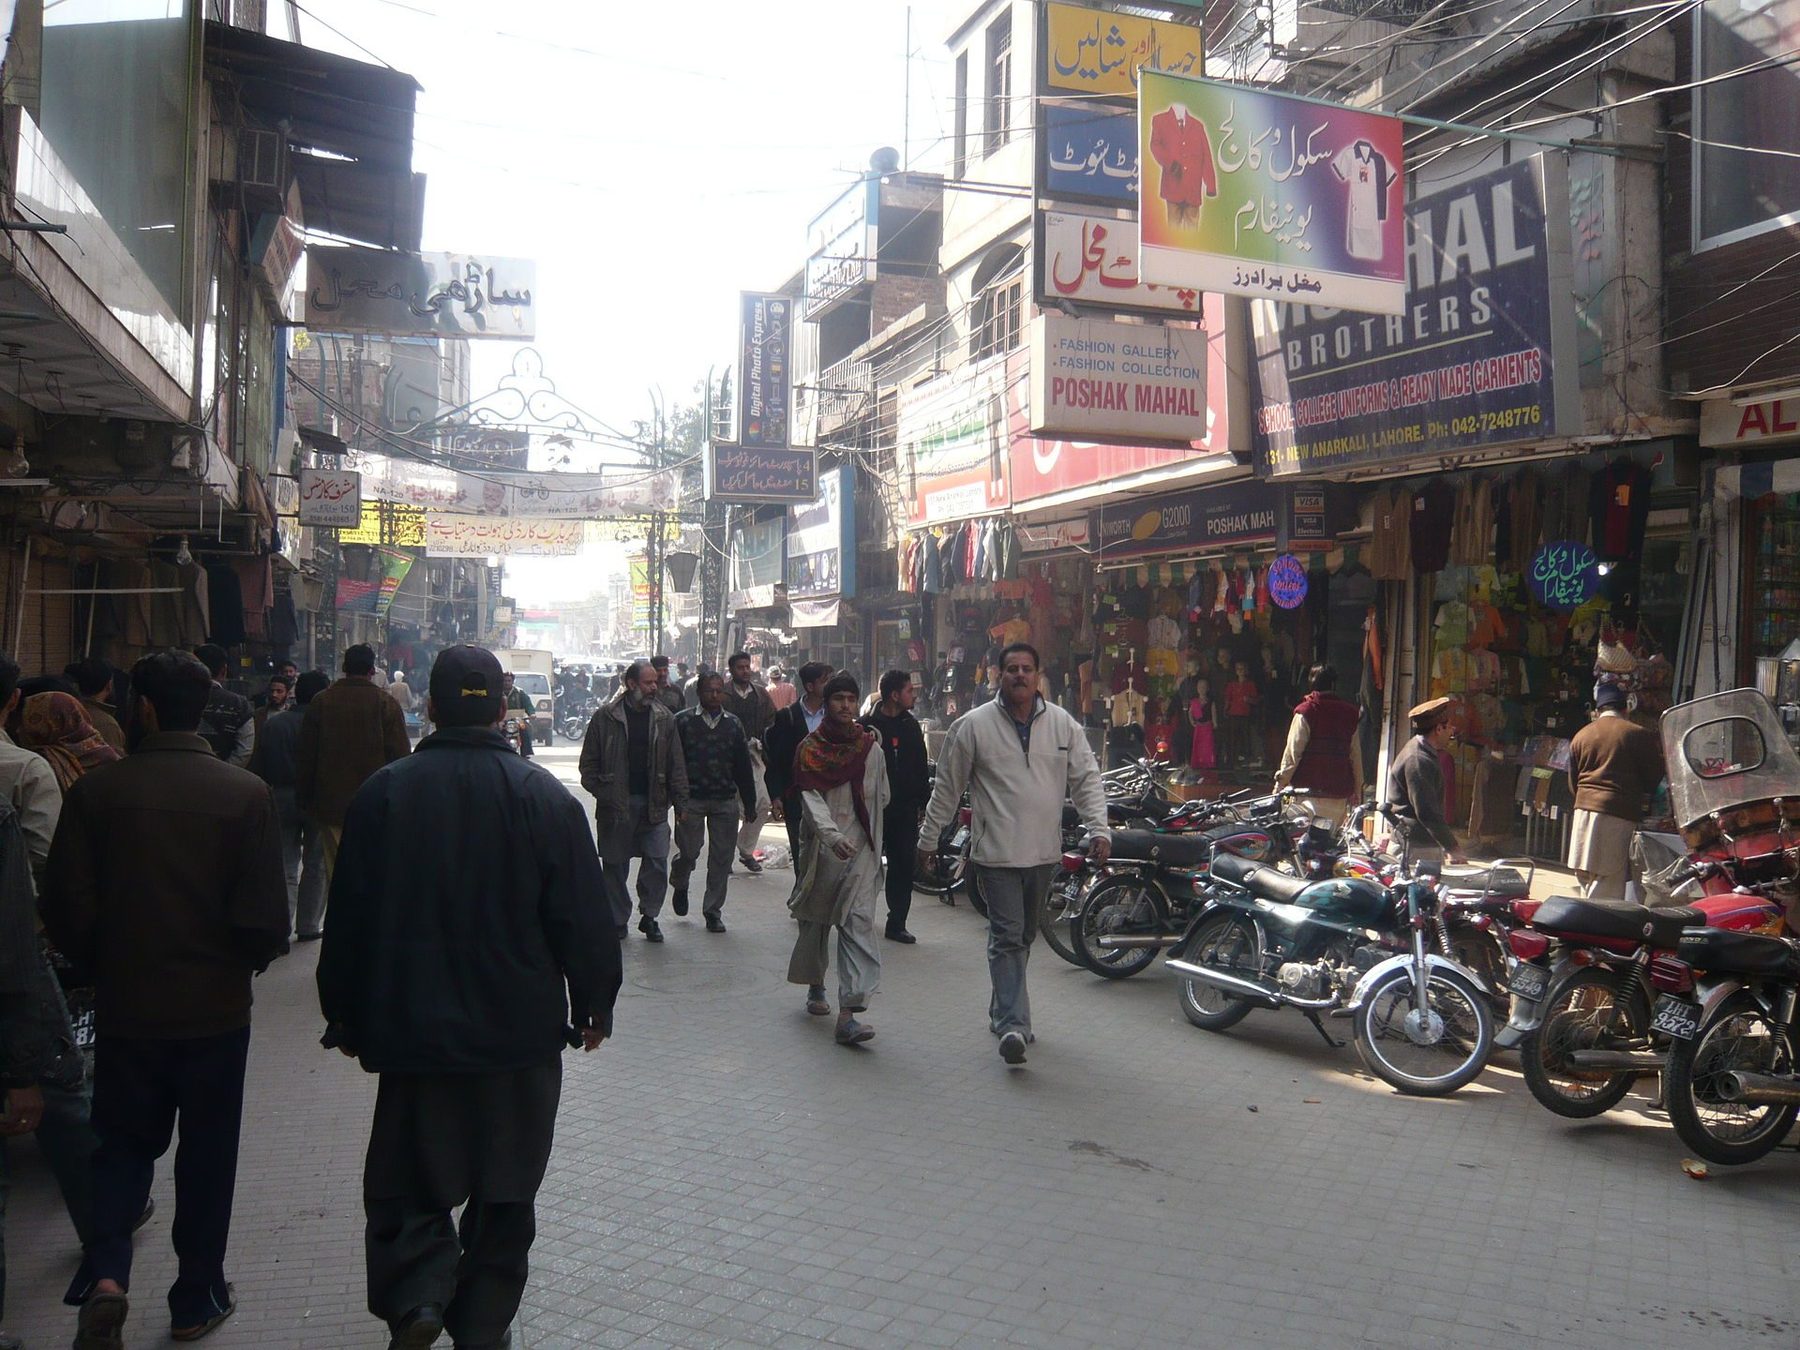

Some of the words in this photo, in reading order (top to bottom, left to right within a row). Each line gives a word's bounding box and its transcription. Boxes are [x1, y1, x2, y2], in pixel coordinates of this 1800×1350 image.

[1055, 17, 1127, 80] شالیں
[1269, 121, 1333, 182] سکول
[1235, 194, 1313, 251] یونیفارم
[1052, 219, 1108, 294] محل
[312, 268, 402, 311] محل
[1233, 267, 1282, 291] برادرز
[1287, 273, 1322, 293] مغل
[752, 301, 764, 345] Express
[1287, 286, 1492, 371] BROTHERS
[752, 347, 762, 378] Photo
[1060, 338, 1115, 354] FASHION
[1122, 344, 1180, 360] GALLERY
[1060, 357, 1115, 372] FASHION
[1122, 362, 1200, 380] COLLECTION
[1296, 392, 1337, 427] COLLEGE
[1338, 382, 1390, 420] UNIFORMS
[1390, 378, 1400, 410] &
[1400, 370, 1437, 407] READY
[1439, 363, 1473, 400] MADE
[1473, 347, 1541, 394] GARMENTS
[751, 380, 763, 417] Digital
[1052, 377, 1128, 411] POSHAK
[1135, 384, 1200, 417] MAHAL
[1286, 444, 1309, 461] NEW
[1428, 421, 1448, 439] Ph:
[1452, 404, 1540, 436] 042-7248776
[1736, 400, 1798, 438] AL
[373, 485, 404, 499] NA-120
[1162, 505, 1191, 529] G2000
[1207, 514, 1249, 536] POSHAK
[1559, 547, 1596, 580] سکول
[1544, 570, 1584, 604] یونیفارم
